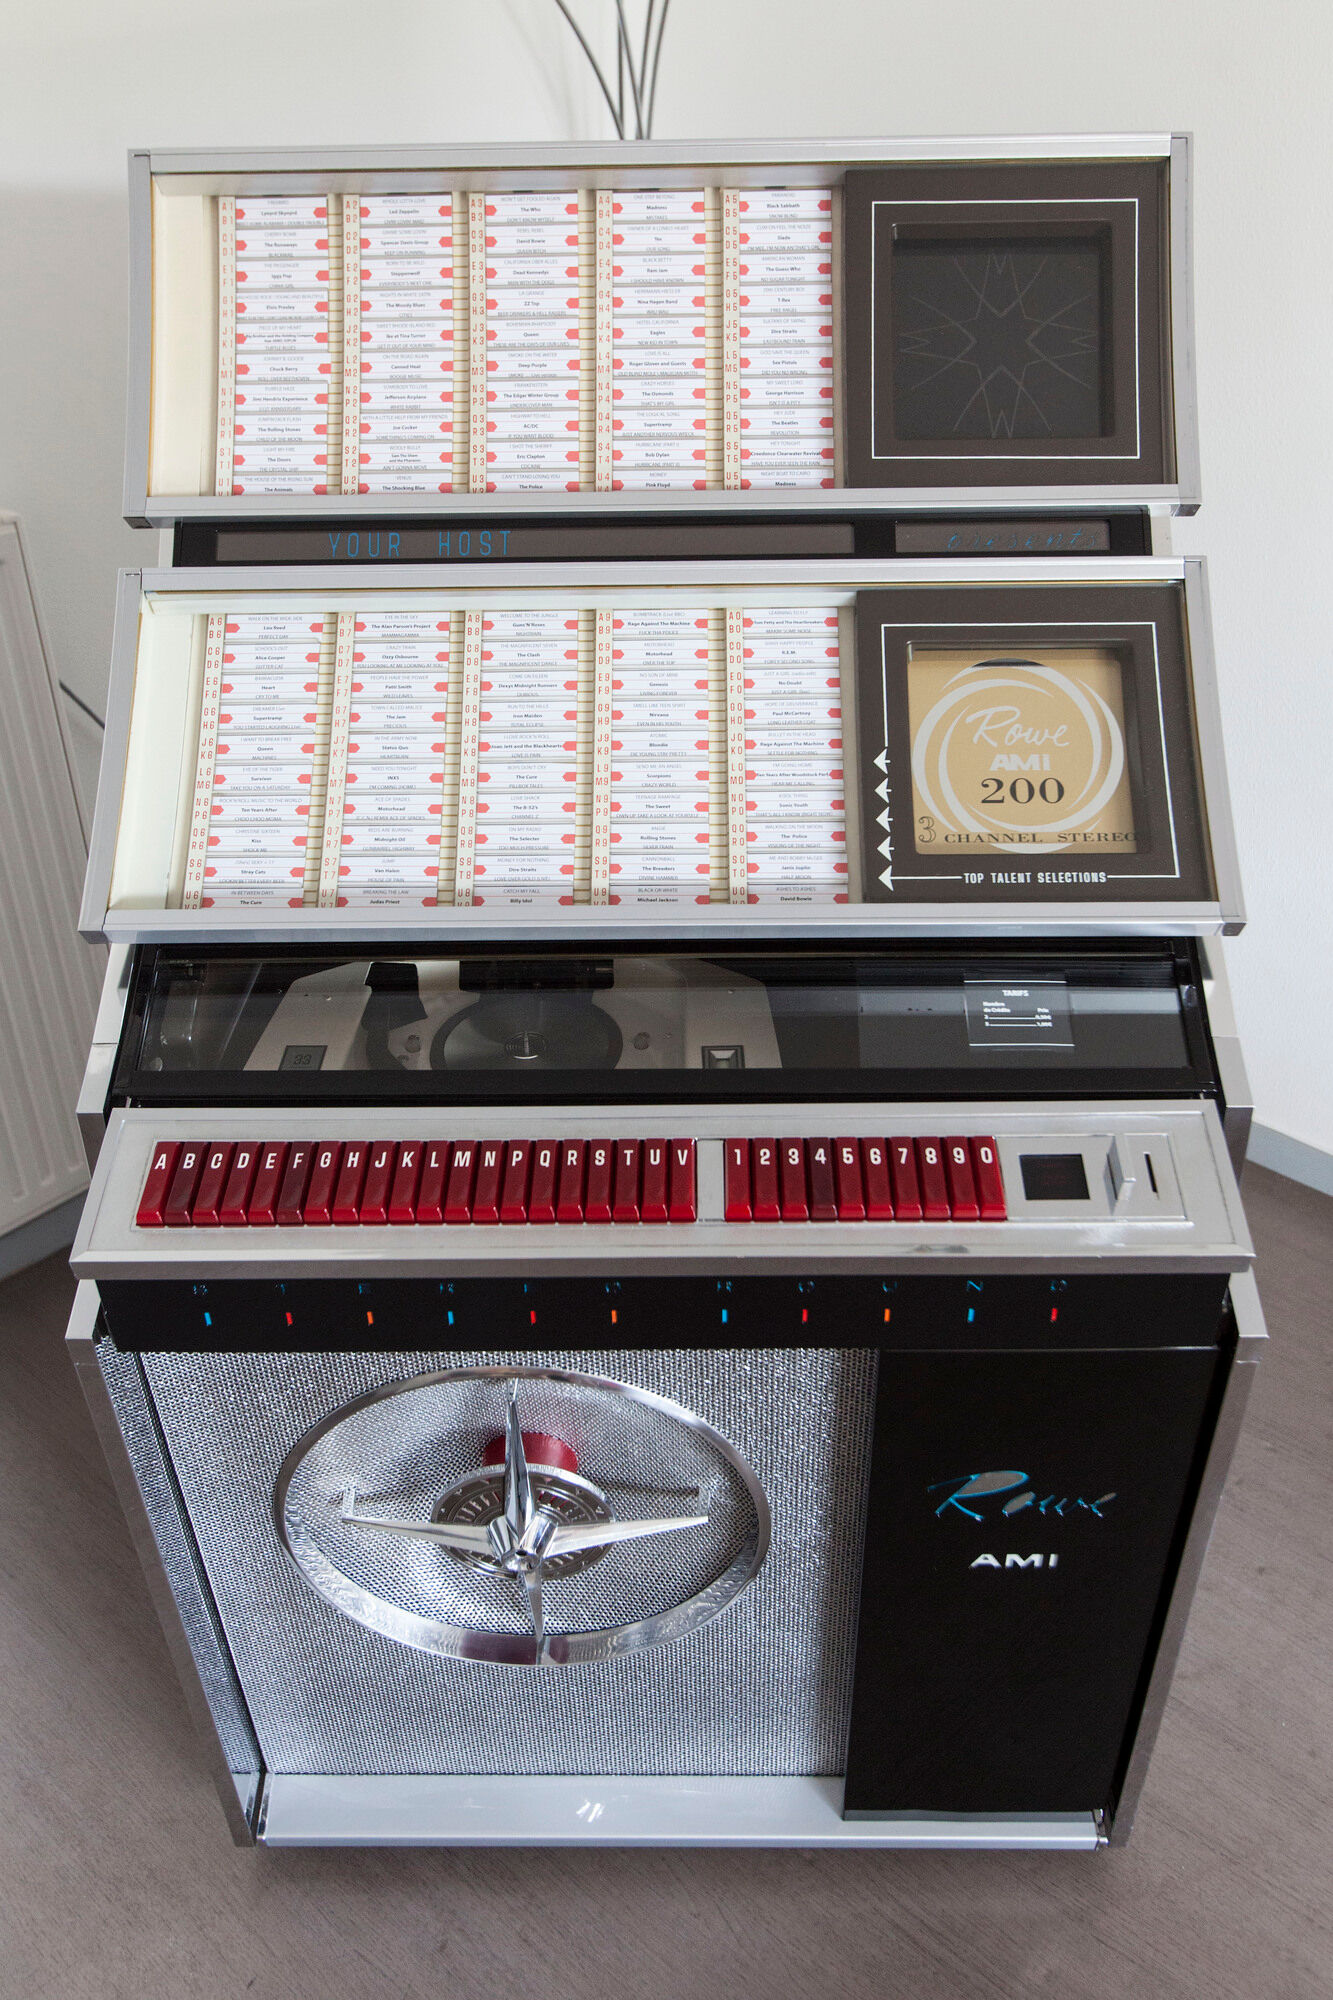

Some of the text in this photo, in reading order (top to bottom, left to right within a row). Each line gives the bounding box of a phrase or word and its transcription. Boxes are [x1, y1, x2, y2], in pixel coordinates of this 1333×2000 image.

[329, 531, 510, 557] YOUR HOST
[965, 706, 1069, 747] Rowe
[989, 754, 1050, 771] AMI
[981, 778, 1064, 803] 200
[918, 816, 1138, 844] 3 CHANNEL STEREO
[964, 872, 1106, 883] TOP TALENT SELECTIONS
[1002, 989, 1029, 997] TARIFS
[155, 1149, 687, 1169] A B C D E F G H J K L M N P Q R S T U V
[735, 1147, 992, 1165] 1 2 3 4 5 6 7 8 9 0
[971, 1554, 1057, 1567] AMI
